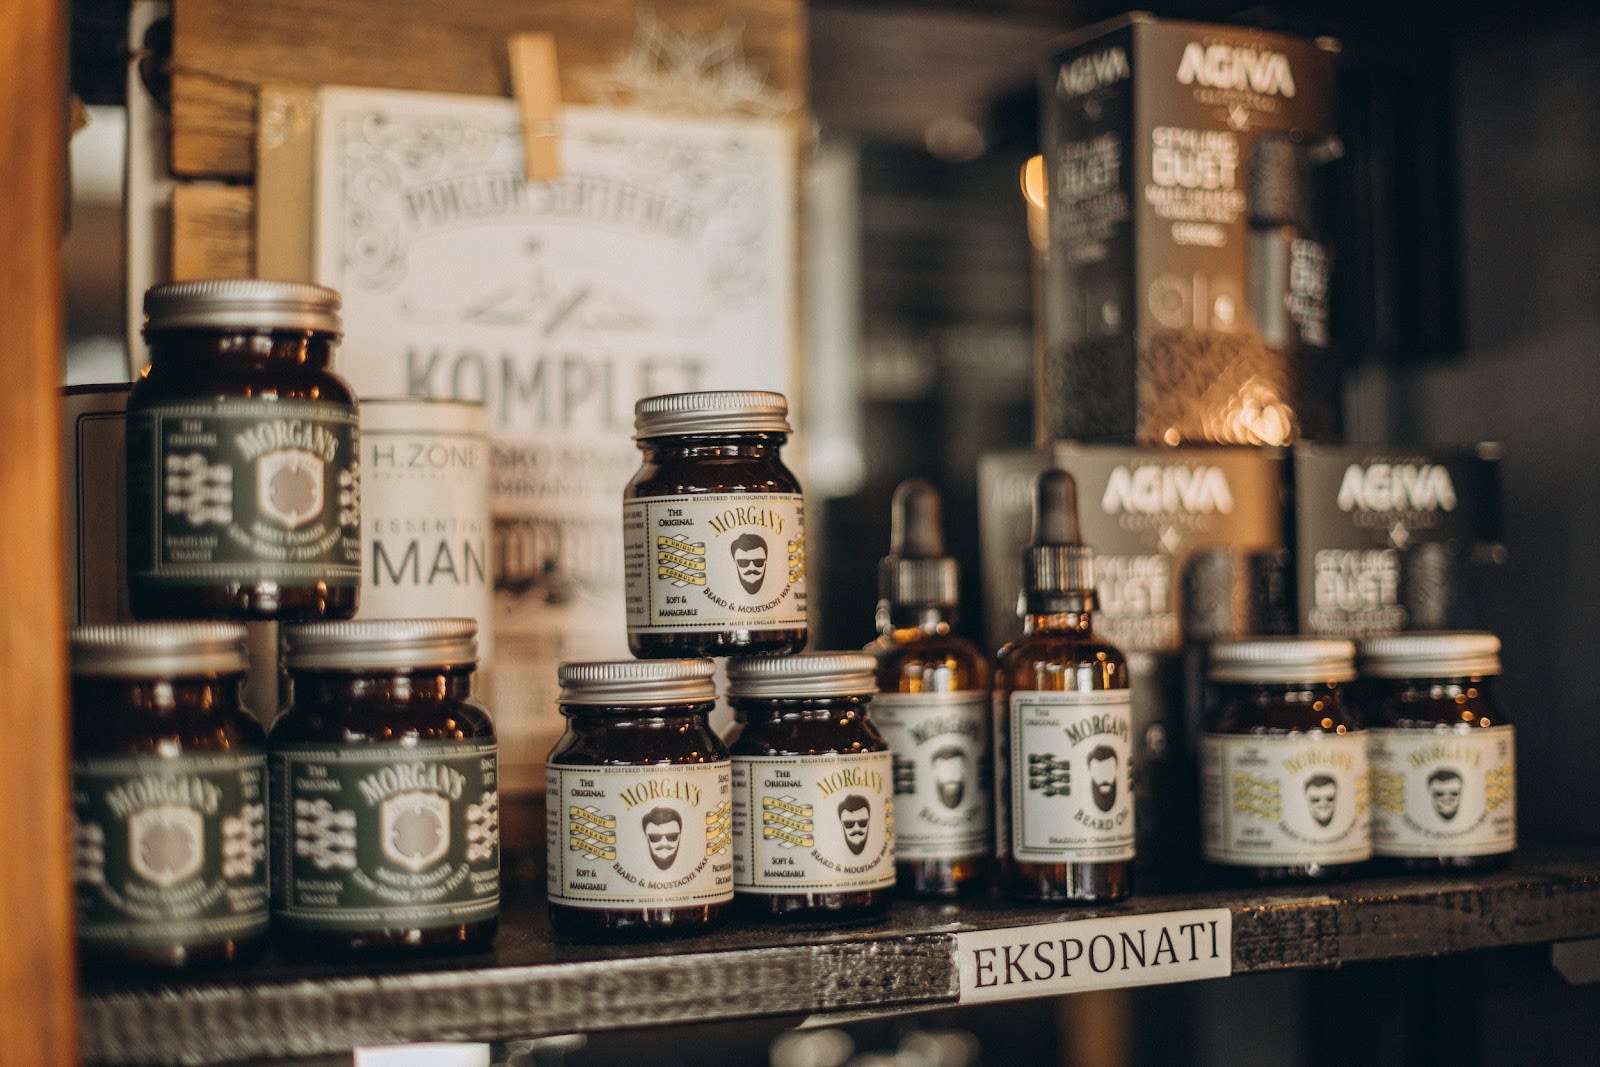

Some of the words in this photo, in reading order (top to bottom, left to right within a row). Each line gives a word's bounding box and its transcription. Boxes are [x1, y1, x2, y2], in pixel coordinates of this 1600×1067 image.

[658, 519, 694, 527] ORIGINAL
[667, 509, 683, 517] THE
[708, 505, 785, 537] MORGAN'S
[372, 540, 486, 587] MAN
[703, 587, 727, 607] BEARD
[729, 603, 735, 611] &
[738, 597, 781, 613] MOUSTACHE
[571, 789, 605, 797] ORIGINAL
[580, 779, 594, 787] THE
[620, 778, 702, 810] MORGAN'S
[764, 780, 802, 788] ORIGINAL
[1074, 809, 1114, 830] BEARD
[612, 862, 637, 883] BEARD
[638, 878, 645, 887] &
[647, 872, 696, 889] MOUSTACHE
[973, 920, 1220, 988] EKSPONATI
